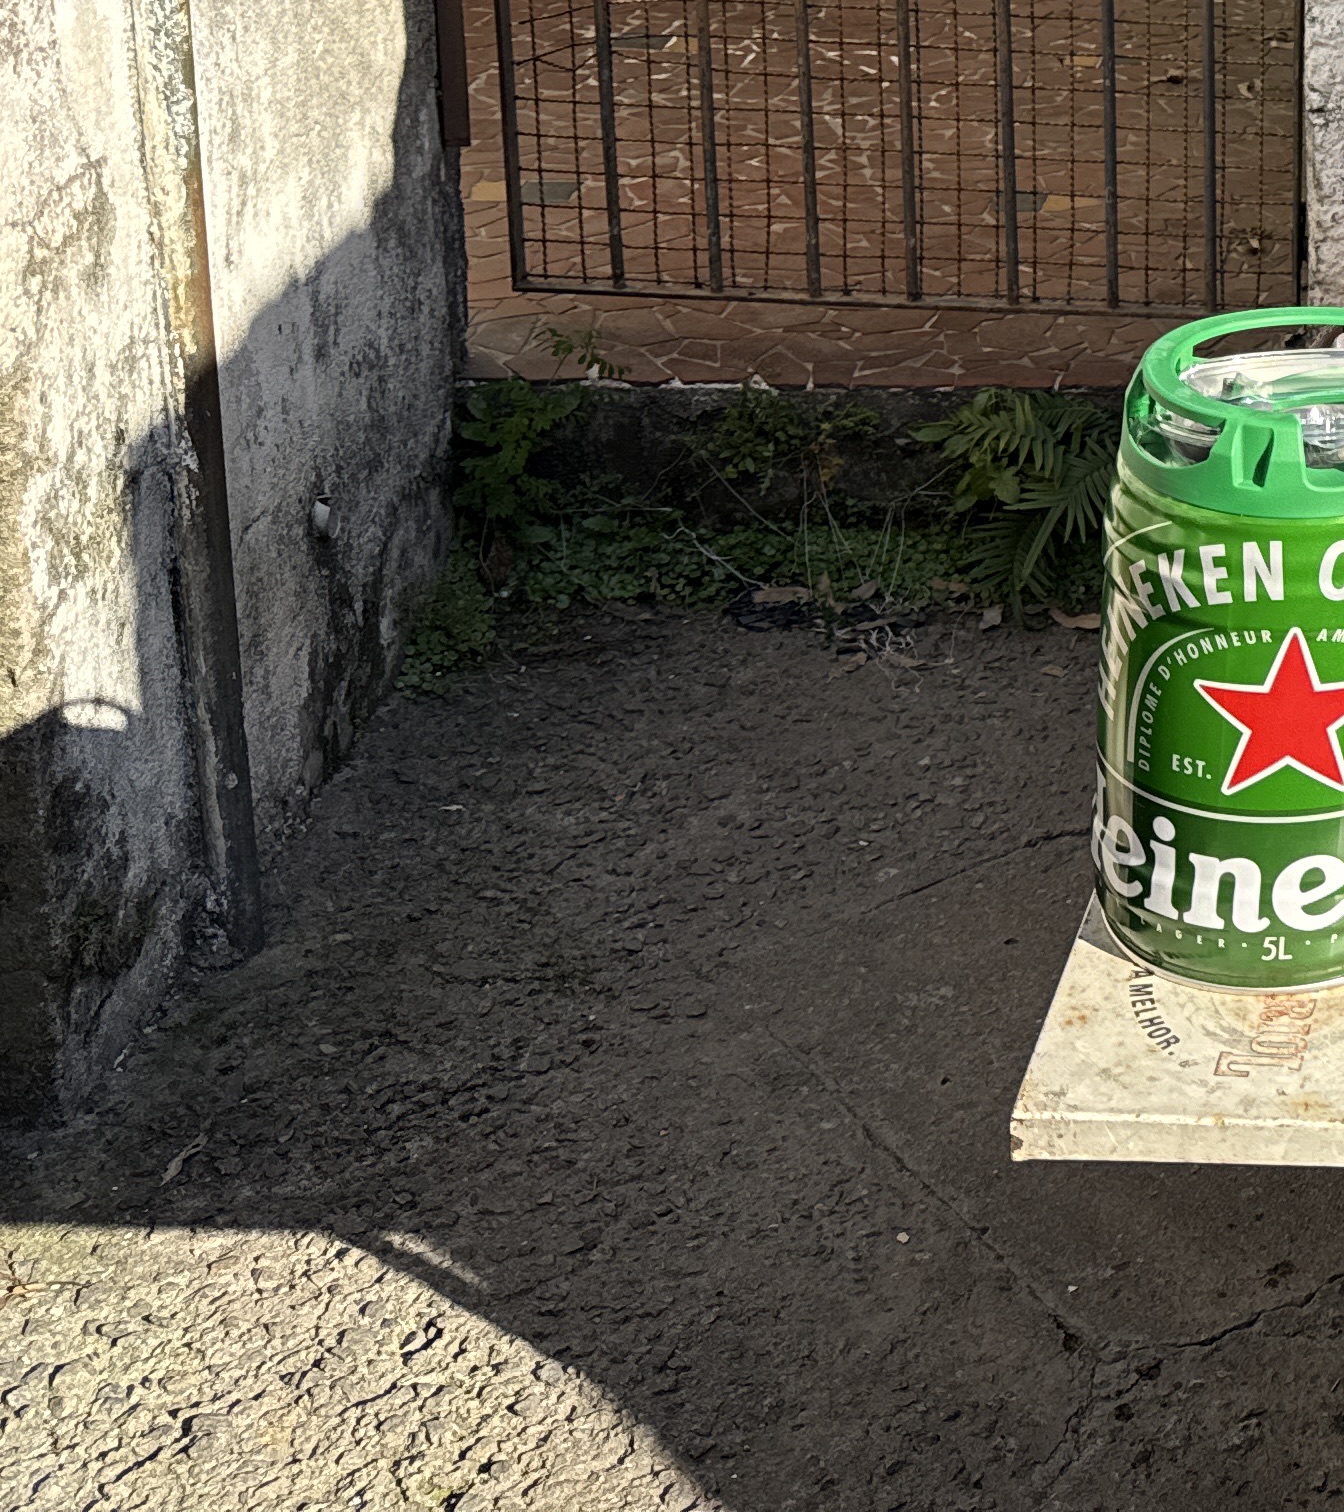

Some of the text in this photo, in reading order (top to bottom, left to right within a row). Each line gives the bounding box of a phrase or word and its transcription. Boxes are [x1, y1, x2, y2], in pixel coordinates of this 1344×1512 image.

[1137, 682, 1162, 772] DIPLOME
[1157, 628, 1273, 681] D'HONNEUR
[1172, 753, 1213, 780] EST.
[1140, 914, 1226, 949] LAGER
[1261, 936, 1294, 962] 5L
[1128, 982, 1181, 1057] MELHOR.
